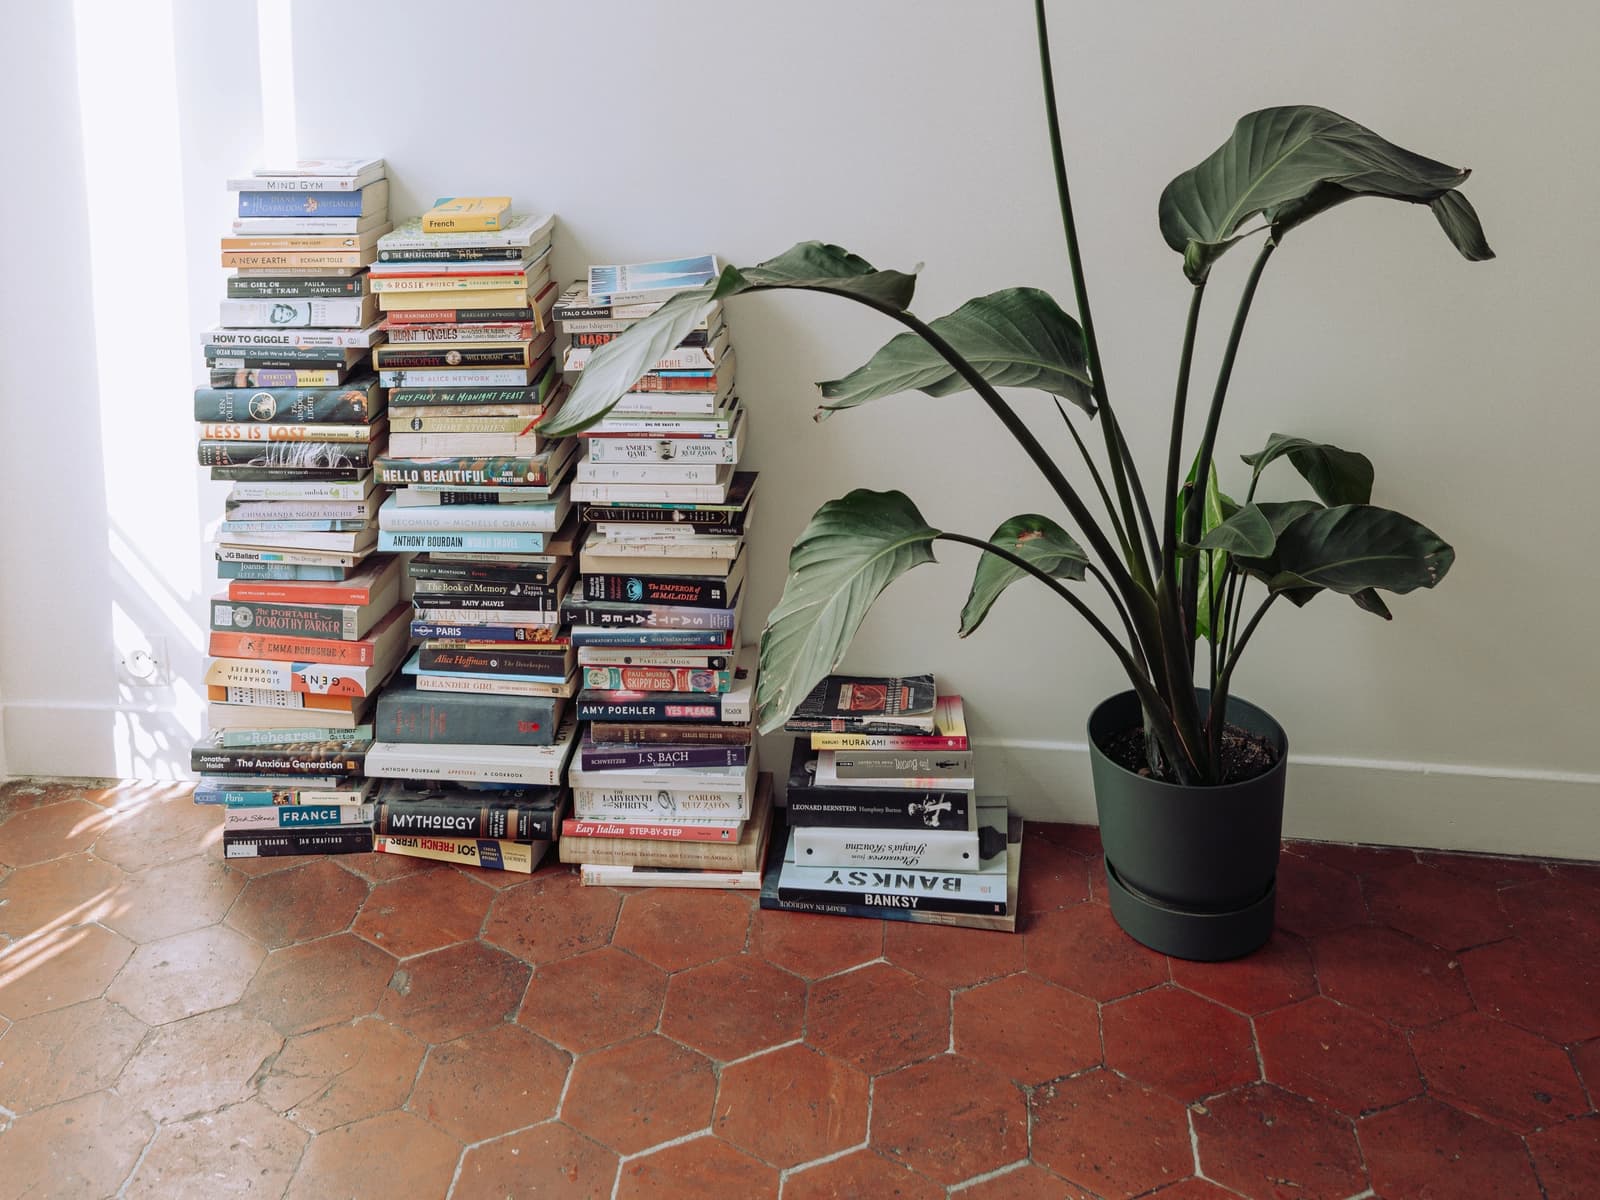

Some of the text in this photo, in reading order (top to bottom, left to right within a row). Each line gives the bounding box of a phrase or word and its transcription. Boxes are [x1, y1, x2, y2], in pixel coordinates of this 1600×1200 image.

[267, 181, 323, 190] MIND GYM
[429, 220, 455, 228] French
[395, 281, 424, 289] ROSIE
[423, 328, 457, 340] TONGUES
[213, 335, 289, 344] HOW TO GIGGLE
[384, 358, 441, 366] PHILOSOPHY
[395, 393, 412, 402] LUCY
[441, 391, 524, 402] THE MIDNIGHT FEAST
[205, 426, 307, 440] LESS IS LOST
[383, 470, 487, 482] HELLO BEAUTIFUL
[393, 536, 425, 547] ANTHONY
[427, 537, 463, 547] BOURDAIN
[235, 552, 259, 560] Ballard
[241, 562, 265, 570] Joanne
[426, 583, 441, 591] The
[464, 584, 473, 592] of
[474, 584, 507, 594] Memory
[271, 609, 319, 619] PORTABLE
[256, 616, 302, 629] DOROTHY
[305, 620, 340, 633] PARKER
[436, 628, 461, 636] PARIS
[435, 655, 488, 667] Alice Hoffman
[231, 666, 278, 675] MUKHERJEE
[228, 675, 280, 684] SIDDHARTHA
[301, 674, 340, 686] GENE
[627, 677, 670, 687] SKIPPY DIES
[582, 706, 655, 714] AMY POEHLER
[667, 706, 715, 716] YES PLEASE
[638, 752, 688, 764] J. S. BACH
[237, 759, 343, 769] The Anxious Generation
[225, 794, 243, 803] Paris
[603, 794, 652, 802] LABYRINTH
[614, 802, 648, 810] SPIRITS
[859, 806, 884, 814] Humphrey
[283, 810, 336, 821] FRANCE
[392, 815, 475, 830] MYTHOLOGY
[576, 824, 682, 836] Easy Italian STEP-BY-STEP
[421, 840, 475, 856] 501 FRENCH
[845, 842, 927, 855] Yiayia's Kouzina
[868, 855, 919, 865] Pleasures
[824, 870, 962, 893] BANKSY
[864, 894, 919, 909] BANKSY
